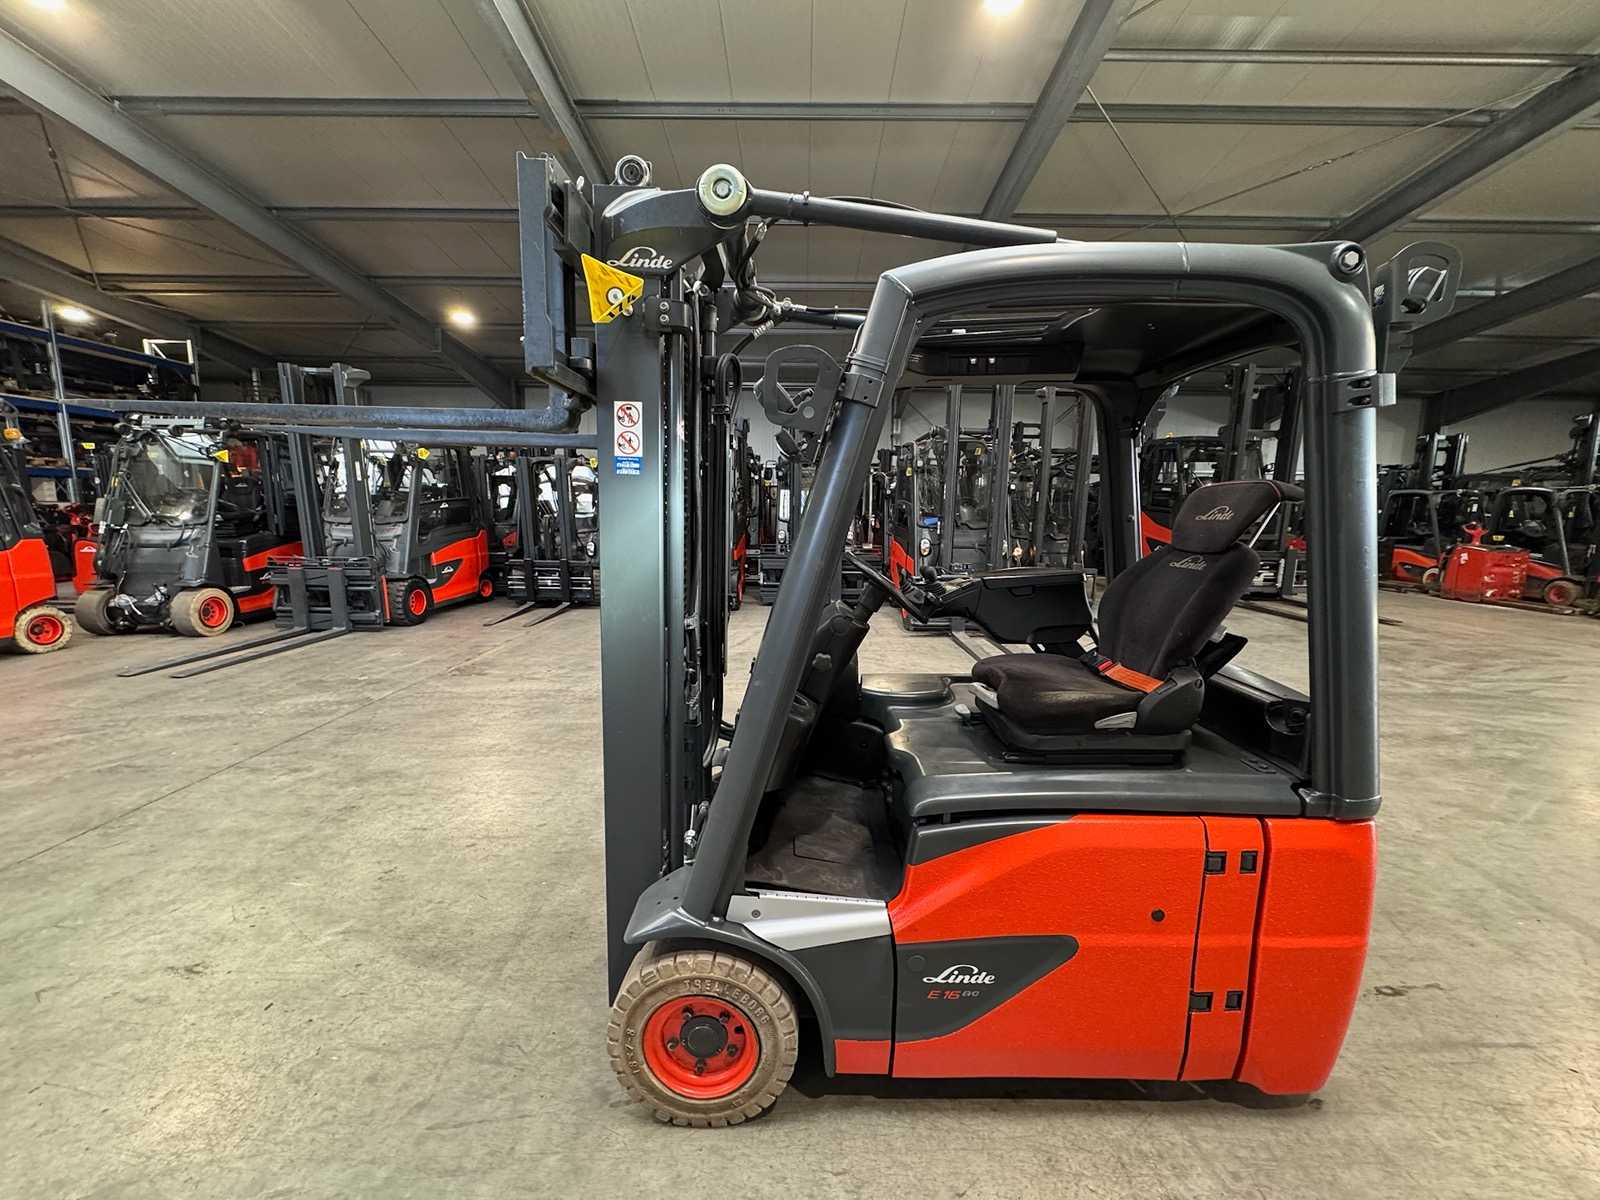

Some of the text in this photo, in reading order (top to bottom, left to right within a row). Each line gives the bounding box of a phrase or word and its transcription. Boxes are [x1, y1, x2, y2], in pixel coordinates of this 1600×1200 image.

[606, 246, 673, 270] Linde
[1195, 505, 1234, 521] Linde
[922, 964, 996, 984] Linde
[927, 990, 941, 999] E
